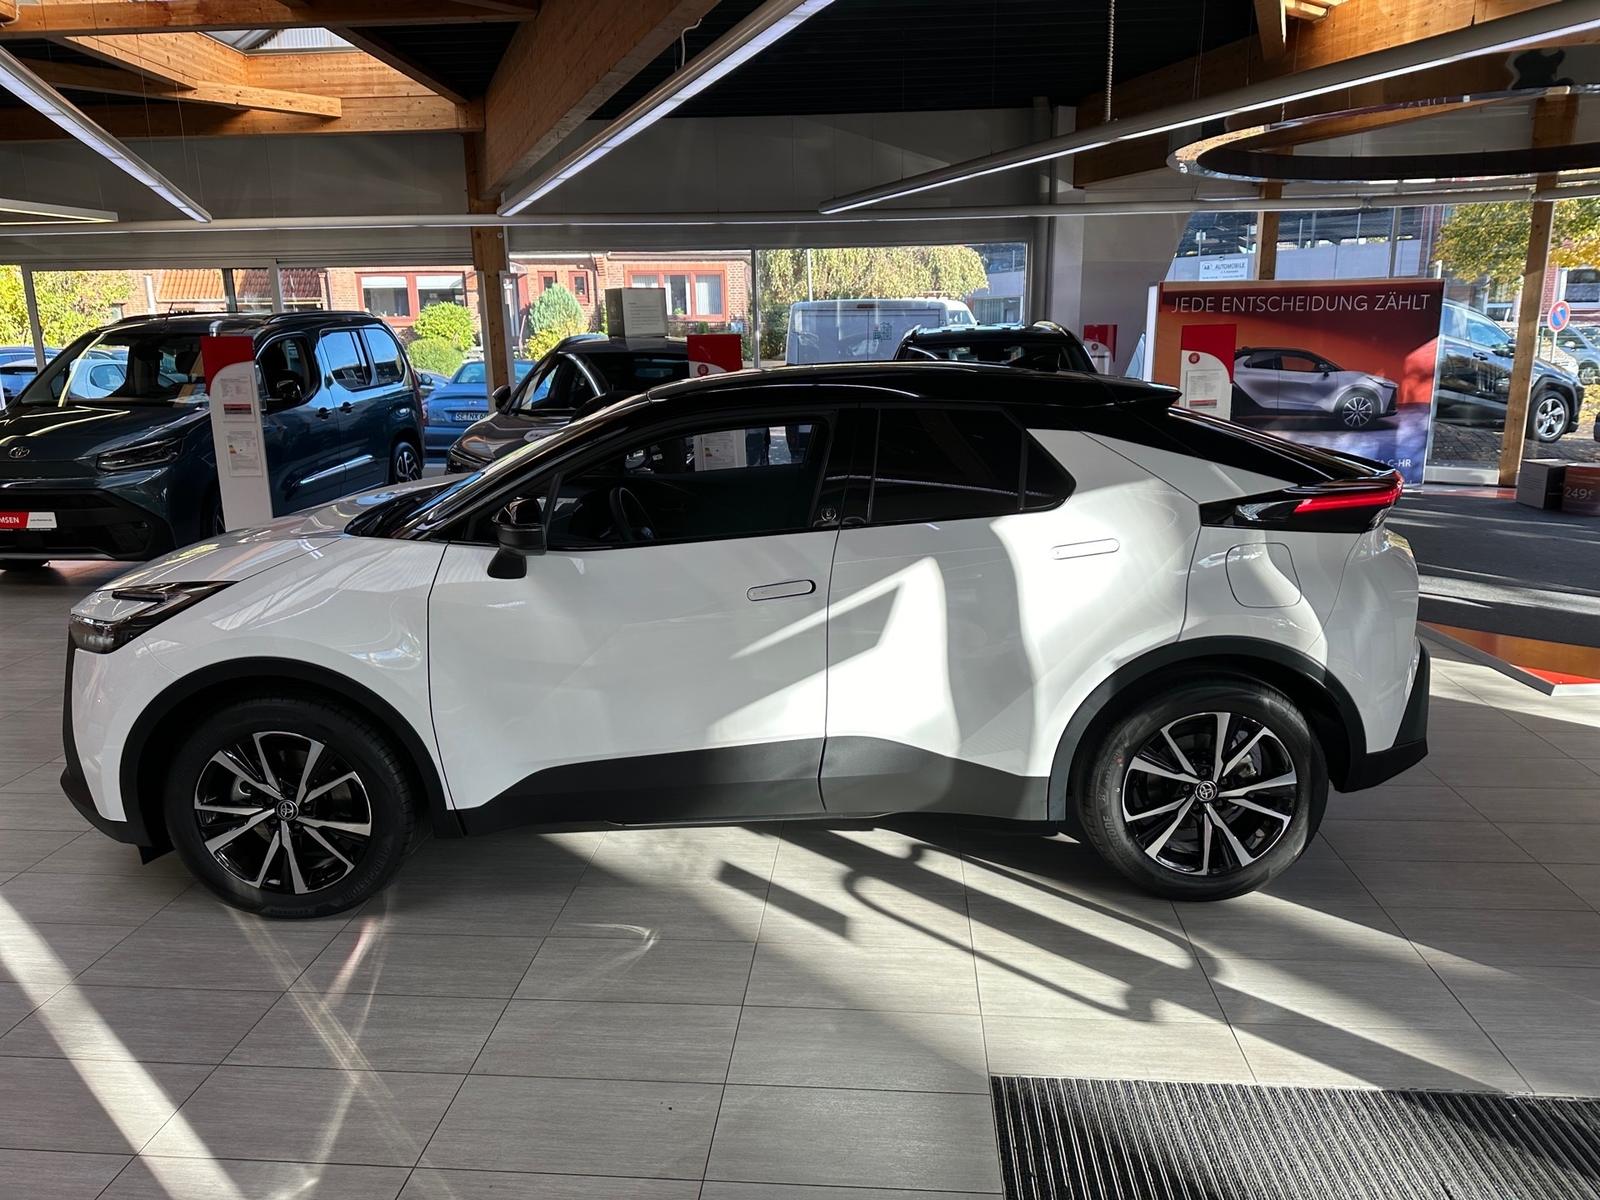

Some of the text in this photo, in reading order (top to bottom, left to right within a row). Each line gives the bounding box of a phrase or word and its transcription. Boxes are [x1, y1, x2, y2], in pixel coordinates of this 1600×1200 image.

[1171, 291, 1431, 313] JEDE ENTSCHEIDUNG ZÄHLT
[1387, 458, 1412, 468] C-HR
